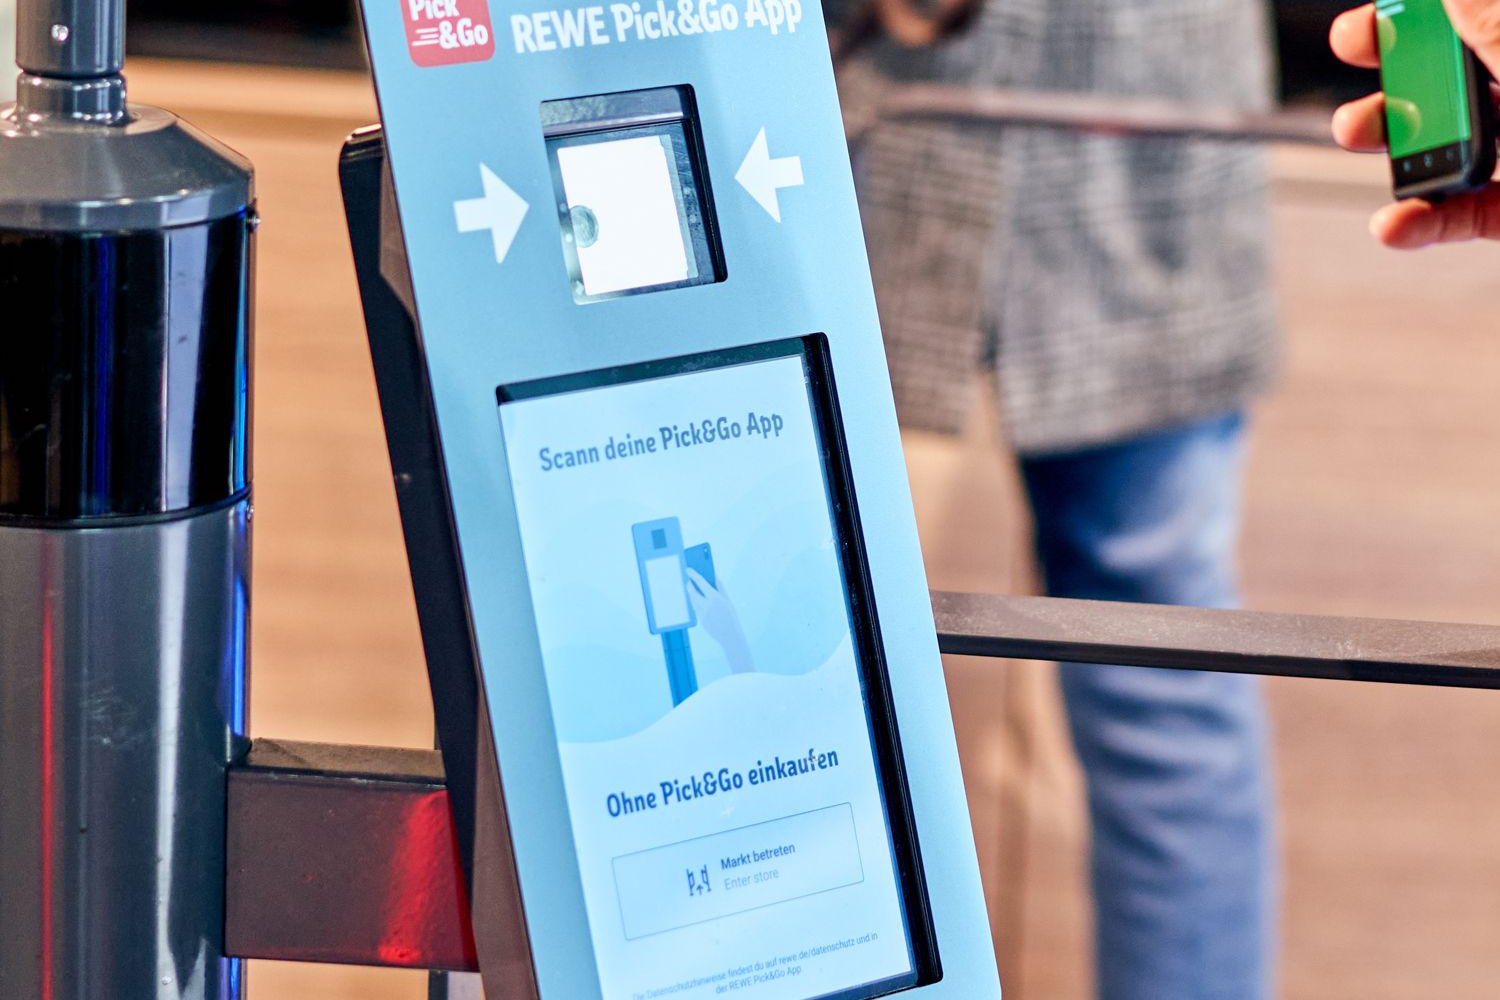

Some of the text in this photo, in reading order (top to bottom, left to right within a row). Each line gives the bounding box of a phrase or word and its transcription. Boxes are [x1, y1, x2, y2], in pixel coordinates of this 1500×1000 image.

[438, 18, 489, 50] &Go
[510, 6, 610, 54] REWE
[539, 411, 783, 472] Scann deine Pick&Go App
[606, 747, 839, 818] Ohne Pick&Go einkaufen
[720, 842, 796, 871] Markt betreten
[723, 868, 780, 891] Enter store
[727, 964, 753, 978] findest
[754, 961, 764, 971] du
[856, 933, 870, 945] und
[871, 932, 878, 940] in
[729, 977, 752, 991] REWE
[753, 970, 785, 984] Pick&Go
[786, 965, 802, 977] App
